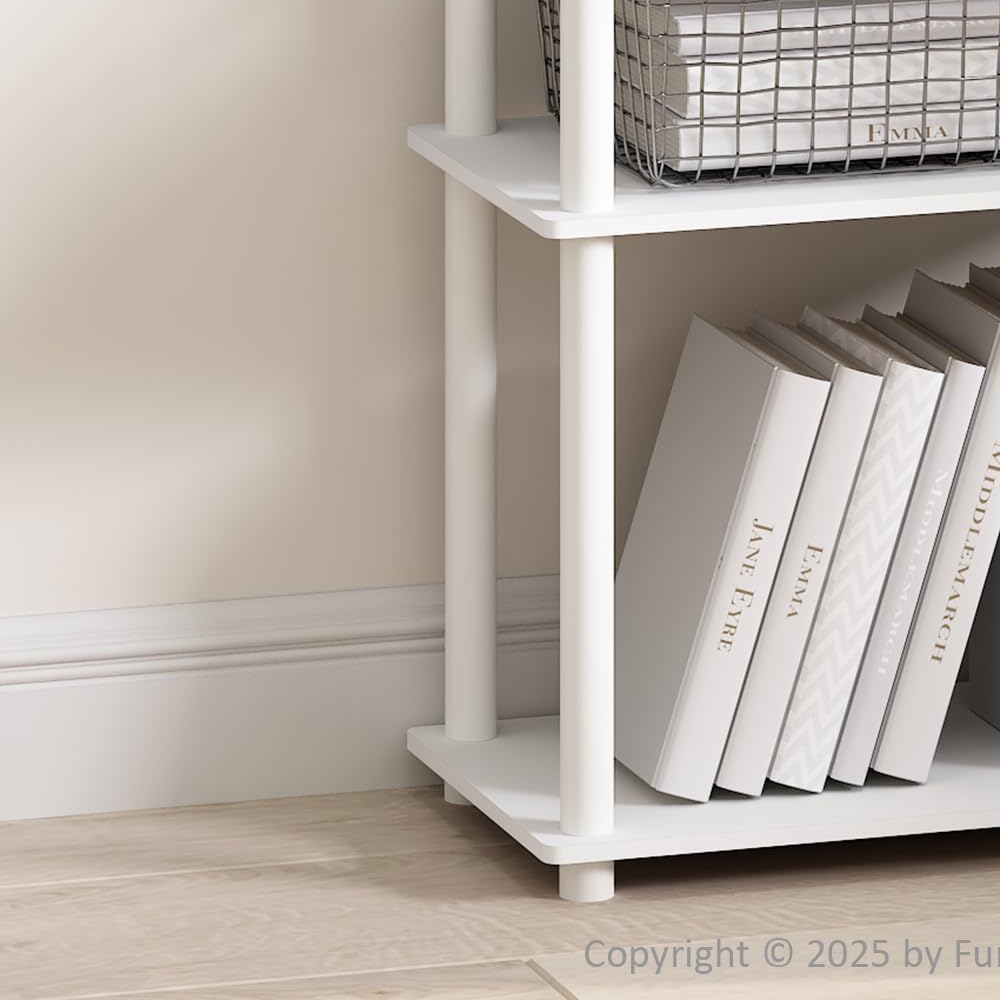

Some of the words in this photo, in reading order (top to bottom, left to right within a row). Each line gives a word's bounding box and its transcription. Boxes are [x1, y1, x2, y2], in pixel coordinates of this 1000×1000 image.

[866, 121, 948, 142] EMMA
[739, 517, 774, 577] JANE
[786, 544, 824, 618] EMMA
[717, 588, 755, 653] EYRE
